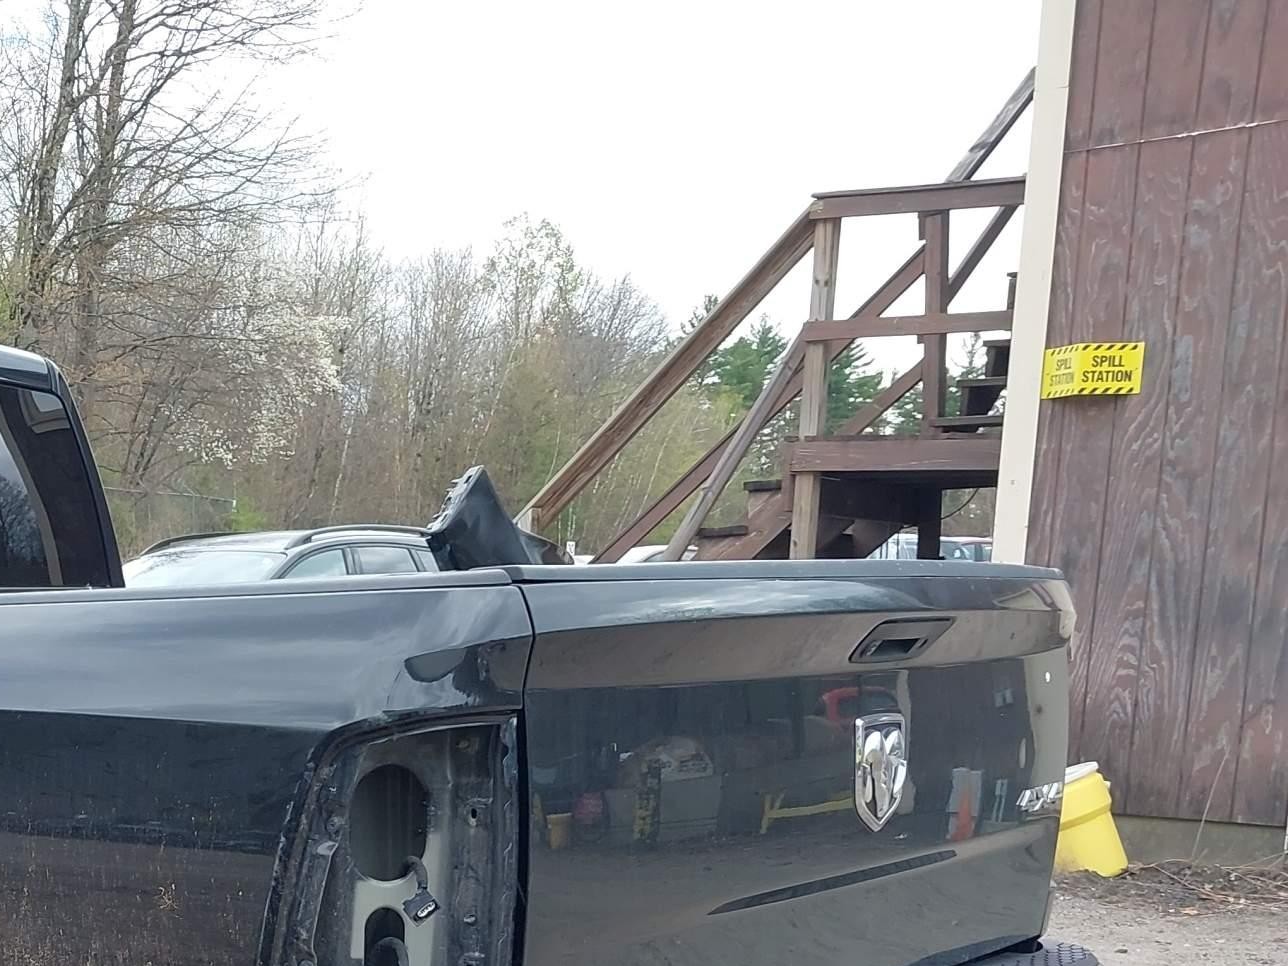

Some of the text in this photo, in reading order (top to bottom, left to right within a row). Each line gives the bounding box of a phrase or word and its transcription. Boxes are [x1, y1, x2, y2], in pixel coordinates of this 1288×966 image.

[1056, 358, 1072, 371] SPILL
[1091, 355, 1125, 368] SPILL
[1081, 370, 1132, 383] STATION
